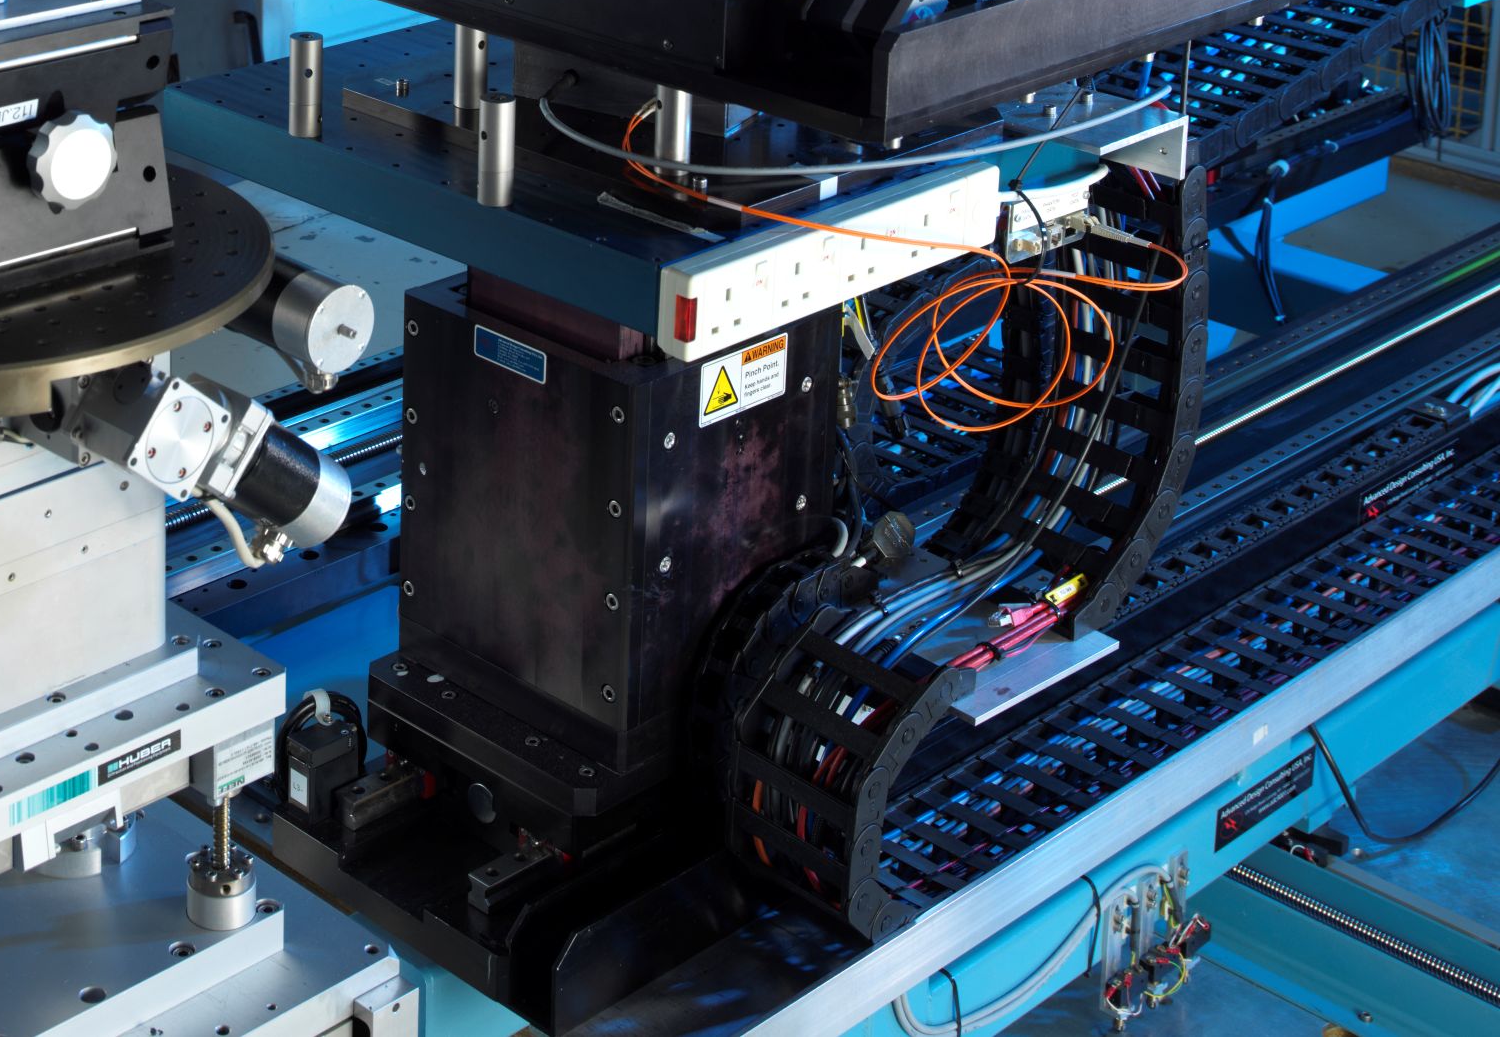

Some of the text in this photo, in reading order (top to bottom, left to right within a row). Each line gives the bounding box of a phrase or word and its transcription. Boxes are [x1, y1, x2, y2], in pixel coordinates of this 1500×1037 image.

[752, 339, 784, 359] WARNING
[745, 361, 780, 379] Pinch Point.
[744, 381, 756, 390] Keep
[756, 376, 770, 385] hands
[744, 388, 760, 398] fingers
[1363, 486, 1389, 506] Advanced
[1389, 476, 1408, 491] Design
[1407, 461, 1434, 481] Consulting
[118, 738, 172, 769] HUBER
[218, 775, 245, 793] NEFF
[1221, 798, 1247, 819] Advanced
[1246, 786, 1265, 802] Design
[1264, 768, 1292, 789] Consulting
